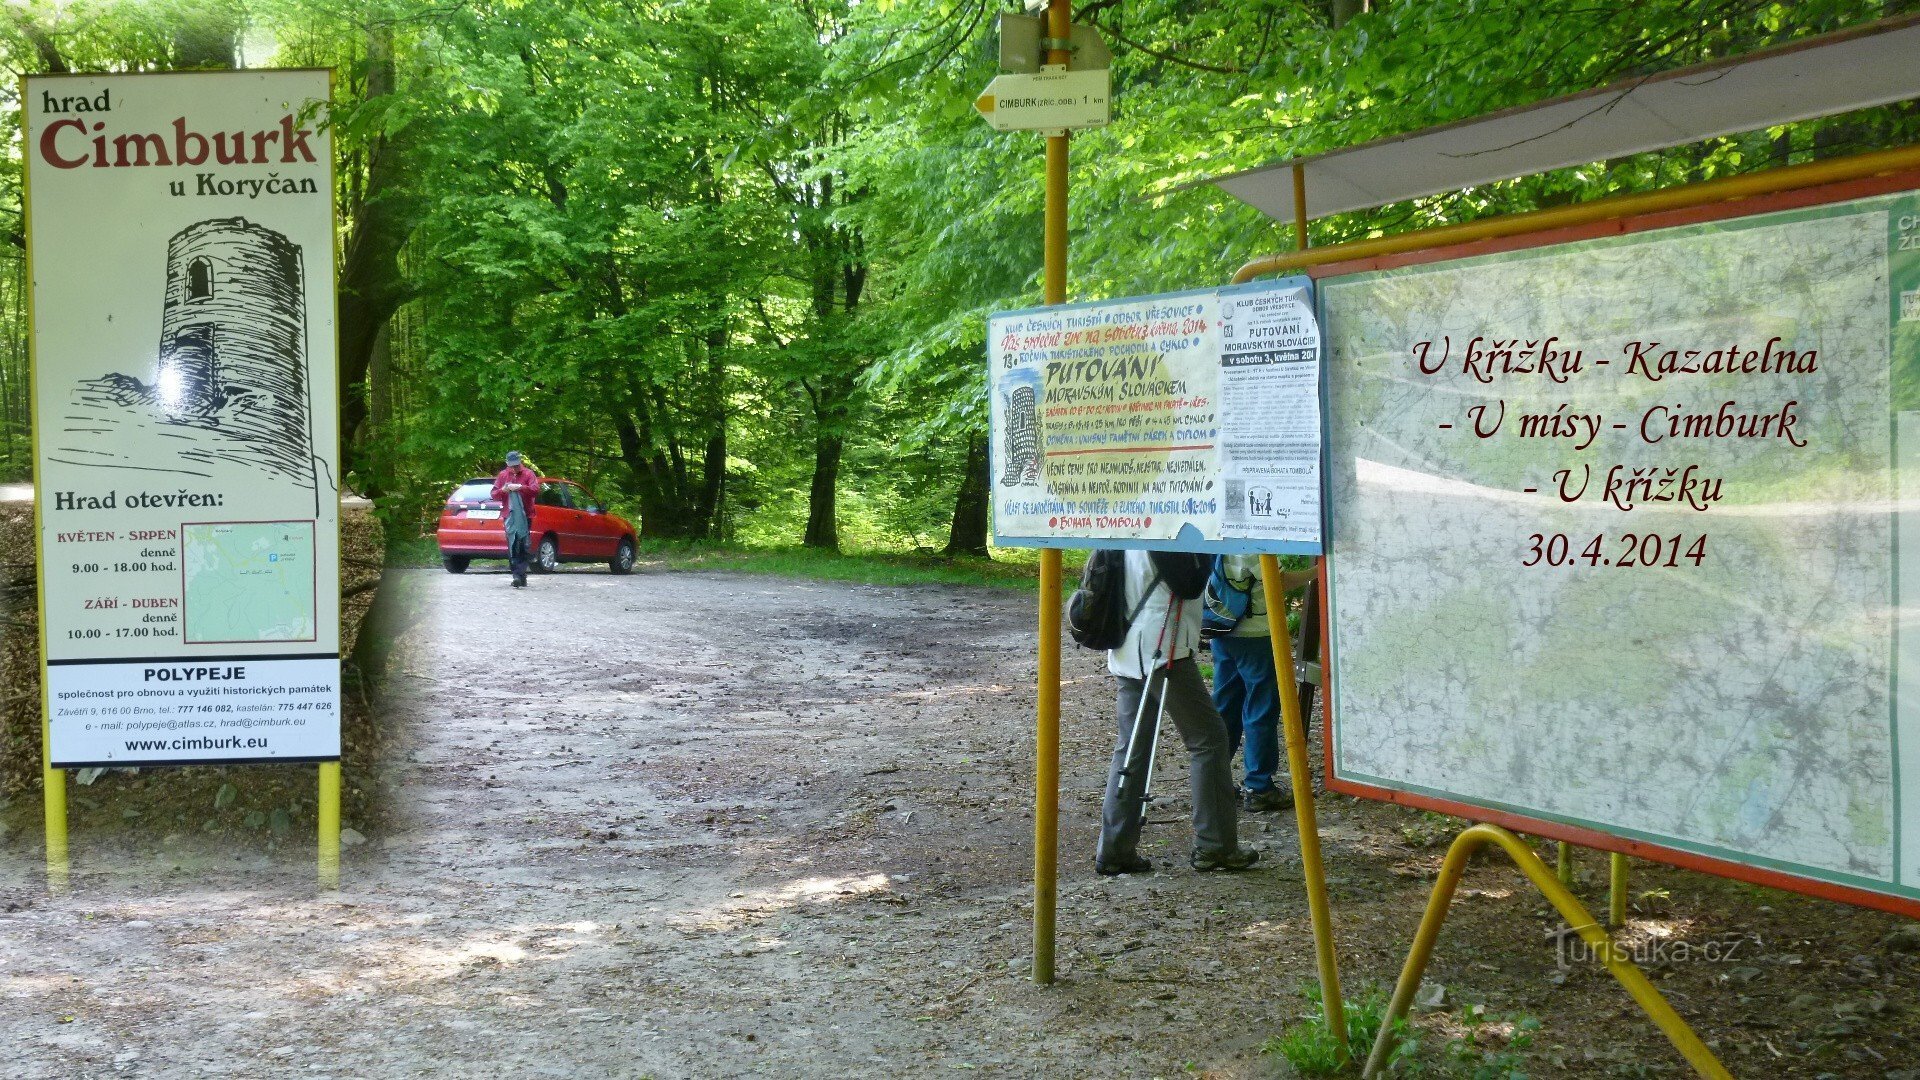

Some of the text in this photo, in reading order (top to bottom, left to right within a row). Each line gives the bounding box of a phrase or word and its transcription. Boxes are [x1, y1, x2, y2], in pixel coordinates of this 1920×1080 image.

[42, 88, 111, 113] hrad
[1000, 97, 1036, 108] CIMBURK
[1083, 95, 1088, 104] 1
[40, 113, 317, 169] Cimburk
[169, 172, 318, 199] u Koryčan
[1236, 300, 1253, 308] KLUB
[1255, 295, 1283, 306] ČESKÝCH
[1005, 322, 1023, 334] KLUB
[1026, 317, 1062, 332] ČESKÝCH
[1112, 311, 1141, 324] ODBOR
[1145, 305, 1194, 320] VŘESOVICE
[1182, 317, 1207, 336] 2014
[1003, 353, 1018, 369] 13.
[1110, 342, 1148, 356] POCHODU
[1151, 341, 1157, 351] A
[1160, 338, 1189, 352] CYKLO
[1236, 355, 1263, 364] sobotu
[1275, 352, 1300, 363] května
[1046, 353, 1164, 387] PUTOVÁNÍ
[1045, 377, 1186, 404] MORAVSKÝM SLOVÁCKEM
[1176, 428, 1208, 441] DIPLOM
[55, 489, 223, 511] Hrad otevřen:
[1060, 515, 1141, 530] BOHATÁ TOMBOLA
[57, 530, 115, 543] KVĚTEN
[129, 530, 176, 541] SRPEN
[140, 547, 176, 557] denně
[72, 564, 99, 573] 9.00
[114, 562, 147, 573] 18.00
[150, 562, 177, 572] hod.
[84, 597, 118, 609] ZÁŘÍ
[132, 598, 178, 608] DUBEN
[142, 613, 177, 623] denně
[68, 629, 101, 639] 10.00
[115, 629, 149, 638] 17.00
[152, 628, 178, 637] hod.
[144, 667, 246, 681] POLYPEJE
[58, 690, 114, 700] společnost
[117, 691, 134, 700] pro
[137, 689, 175, 697] obnovu
[187, 686, 220, 698] využití
[223, 685, 286, 697] historických
[288, 684, 332, 695] památek
[91, 708, 99, 717] 9,
[101, 708, 118, 716] 616
[121, 707, 131, 715] 00
[133, 706, 156, 716] Brno,
[159, 705, 175, 714] tel.:
[178, 706, 194, 714] 777
[215, 705, 234, 714] 082,
[236, 703, 275, 712] kastelán:
[278, 703, 294, 711] 775
[297, 703, 313, 711] 447
[315, 702, 332, 710] 626
[100, 721, 123, 730] mail:
[126, 719, 217, 732] polypeje@atlas.cz,
[220, 717, 306, 729] hrad@cimburk.eu
[125, 735, 268, 751] www.cimburk.eu
